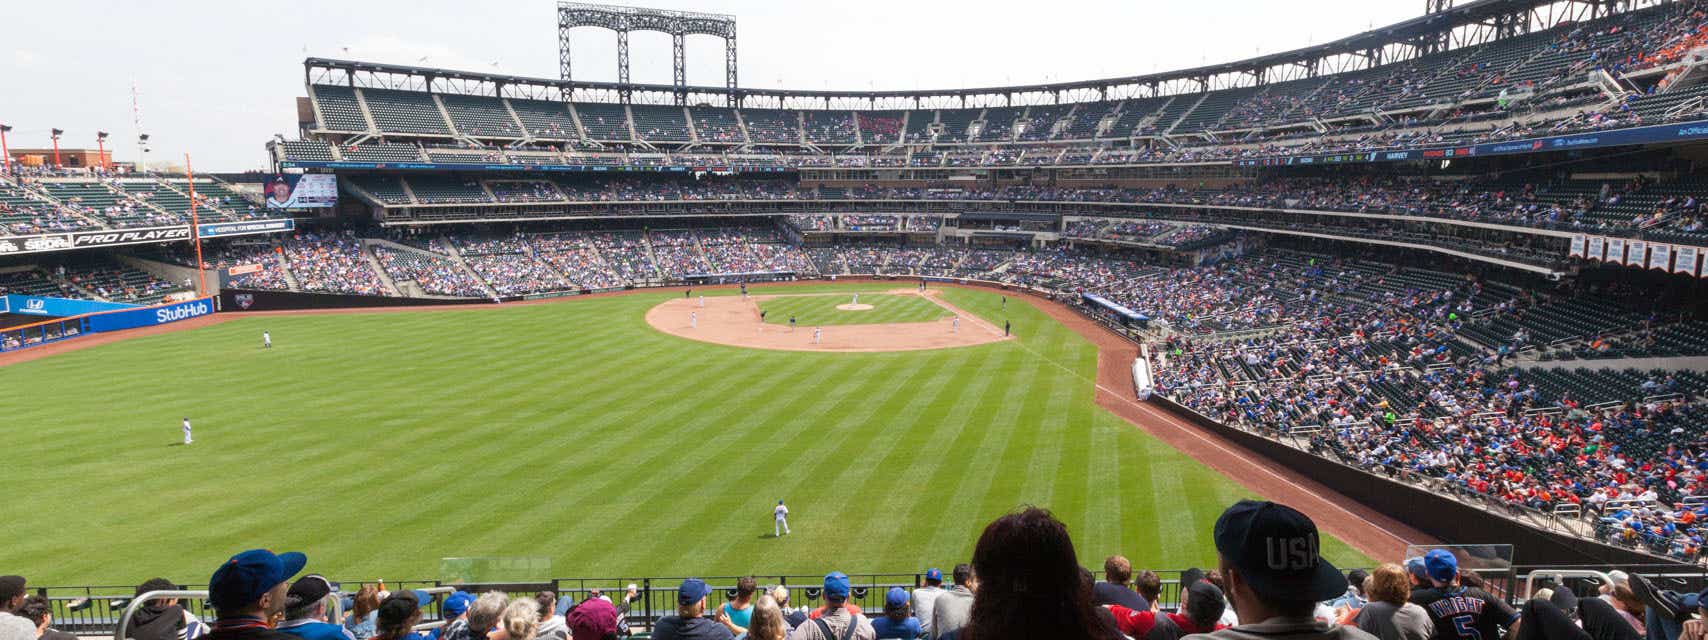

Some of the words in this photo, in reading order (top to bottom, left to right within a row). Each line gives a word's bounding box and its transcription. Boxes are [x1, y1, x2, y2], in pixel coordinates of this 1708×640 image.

[75, 233, 119, 245] PRO
[119, 228, 188, 241] PLAYER
[156, 302, 208, 323] StubHub
[1266, 532, 1319, 570] USA
[1429, 596, 1485, 618] WRIGHT
[1452, 614, 1481, 640] 5
